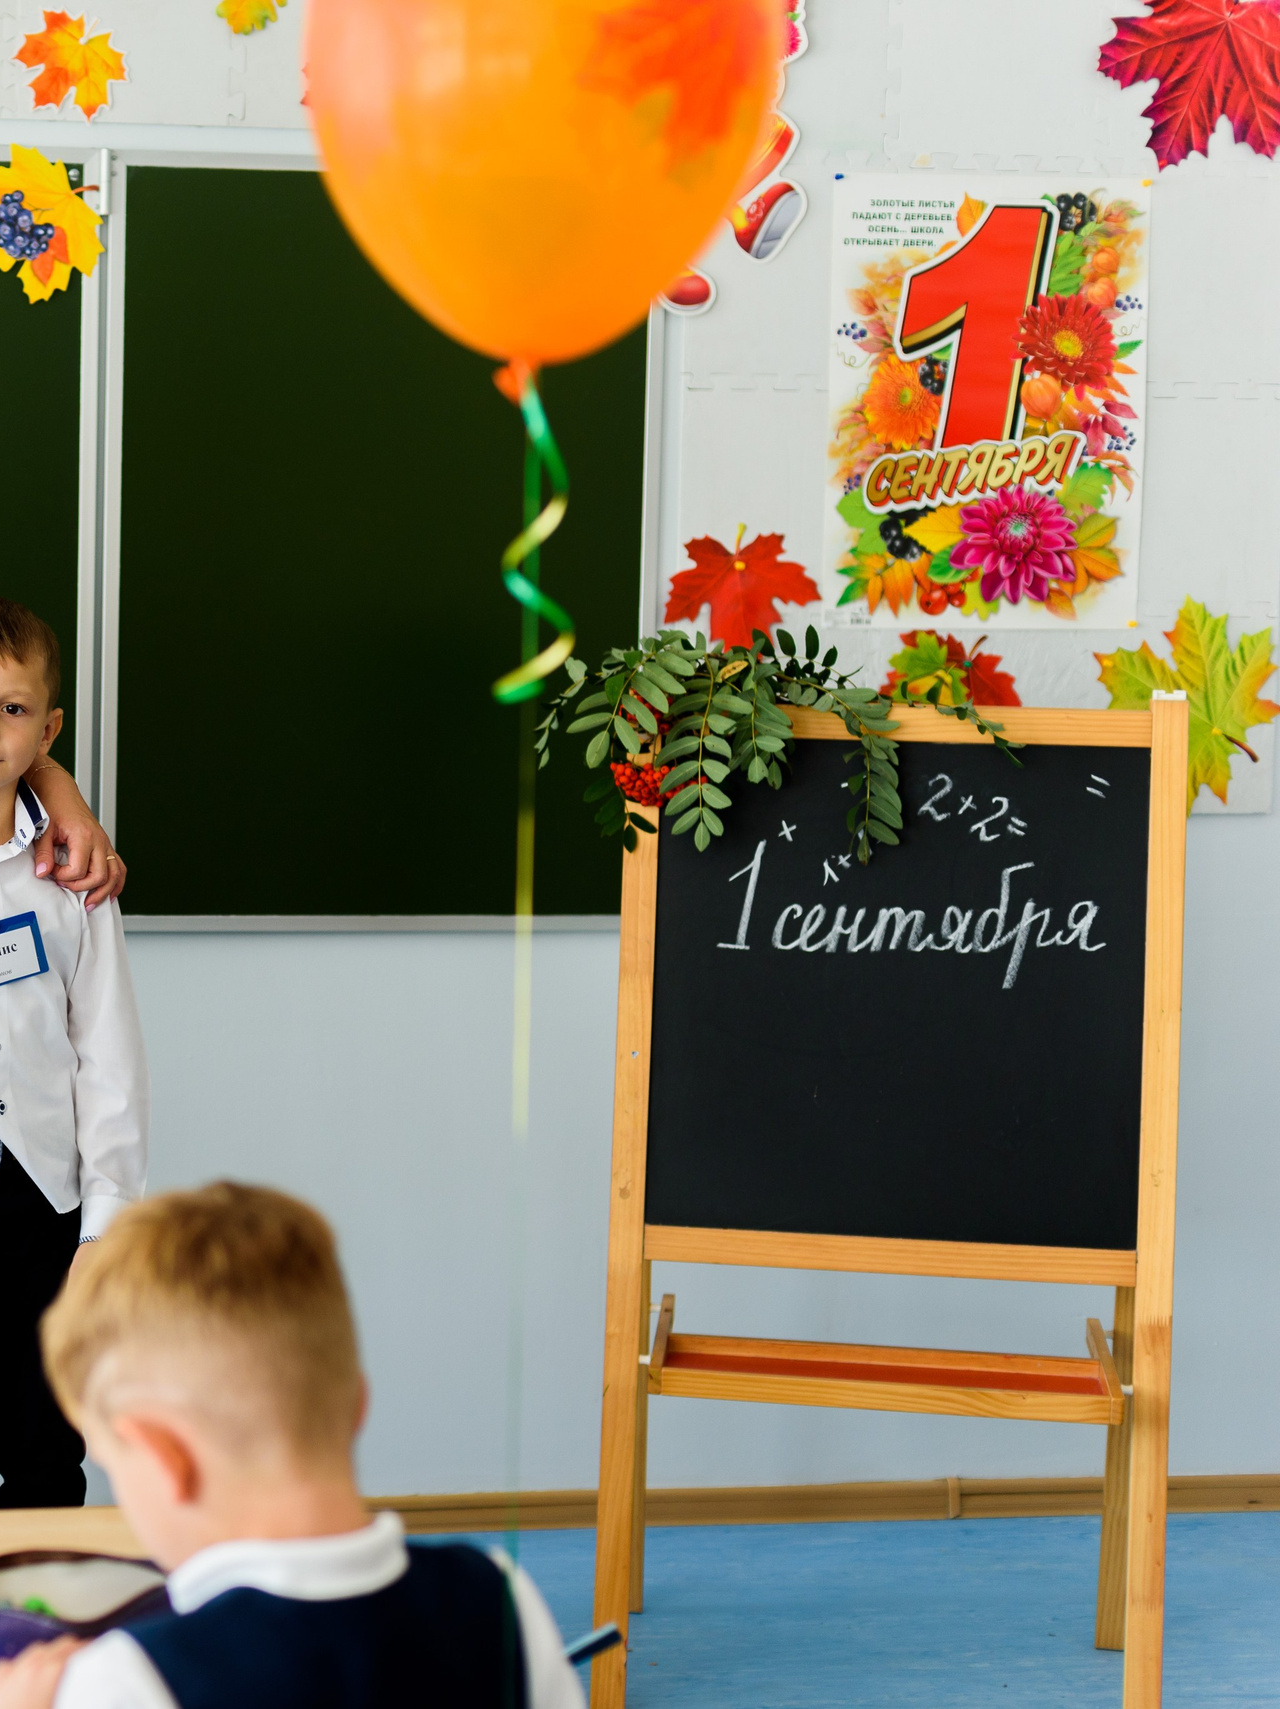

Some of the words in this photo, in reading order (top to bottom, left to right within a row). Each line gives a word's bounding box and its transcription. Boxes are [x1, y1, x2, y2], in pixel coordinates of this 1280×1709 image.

[870, 199, 915, 208] ЗОЛОТЫЕ
[918, 200, 955, 208] ЛИСТЬЯ
[852, 211, 892, 221] ПАДАЮТ
[895, 212, 902, 220] С
[904, 212, 955, 222] ДЕРЕВЬЕВ.
[910, 226, 944, 234] ШКОЛА
[843, 237, 900, 246] ОТКРЫВАЕТ
[903, 238, 936, 248] ДВЕРИ.
[901, 205, 1051, 449] 1
[866, 433, 1080, 507] СЕНТЯБРЯ
[716, 838, 767, 950] 1
[771, 861, 1107, 989] сентября
